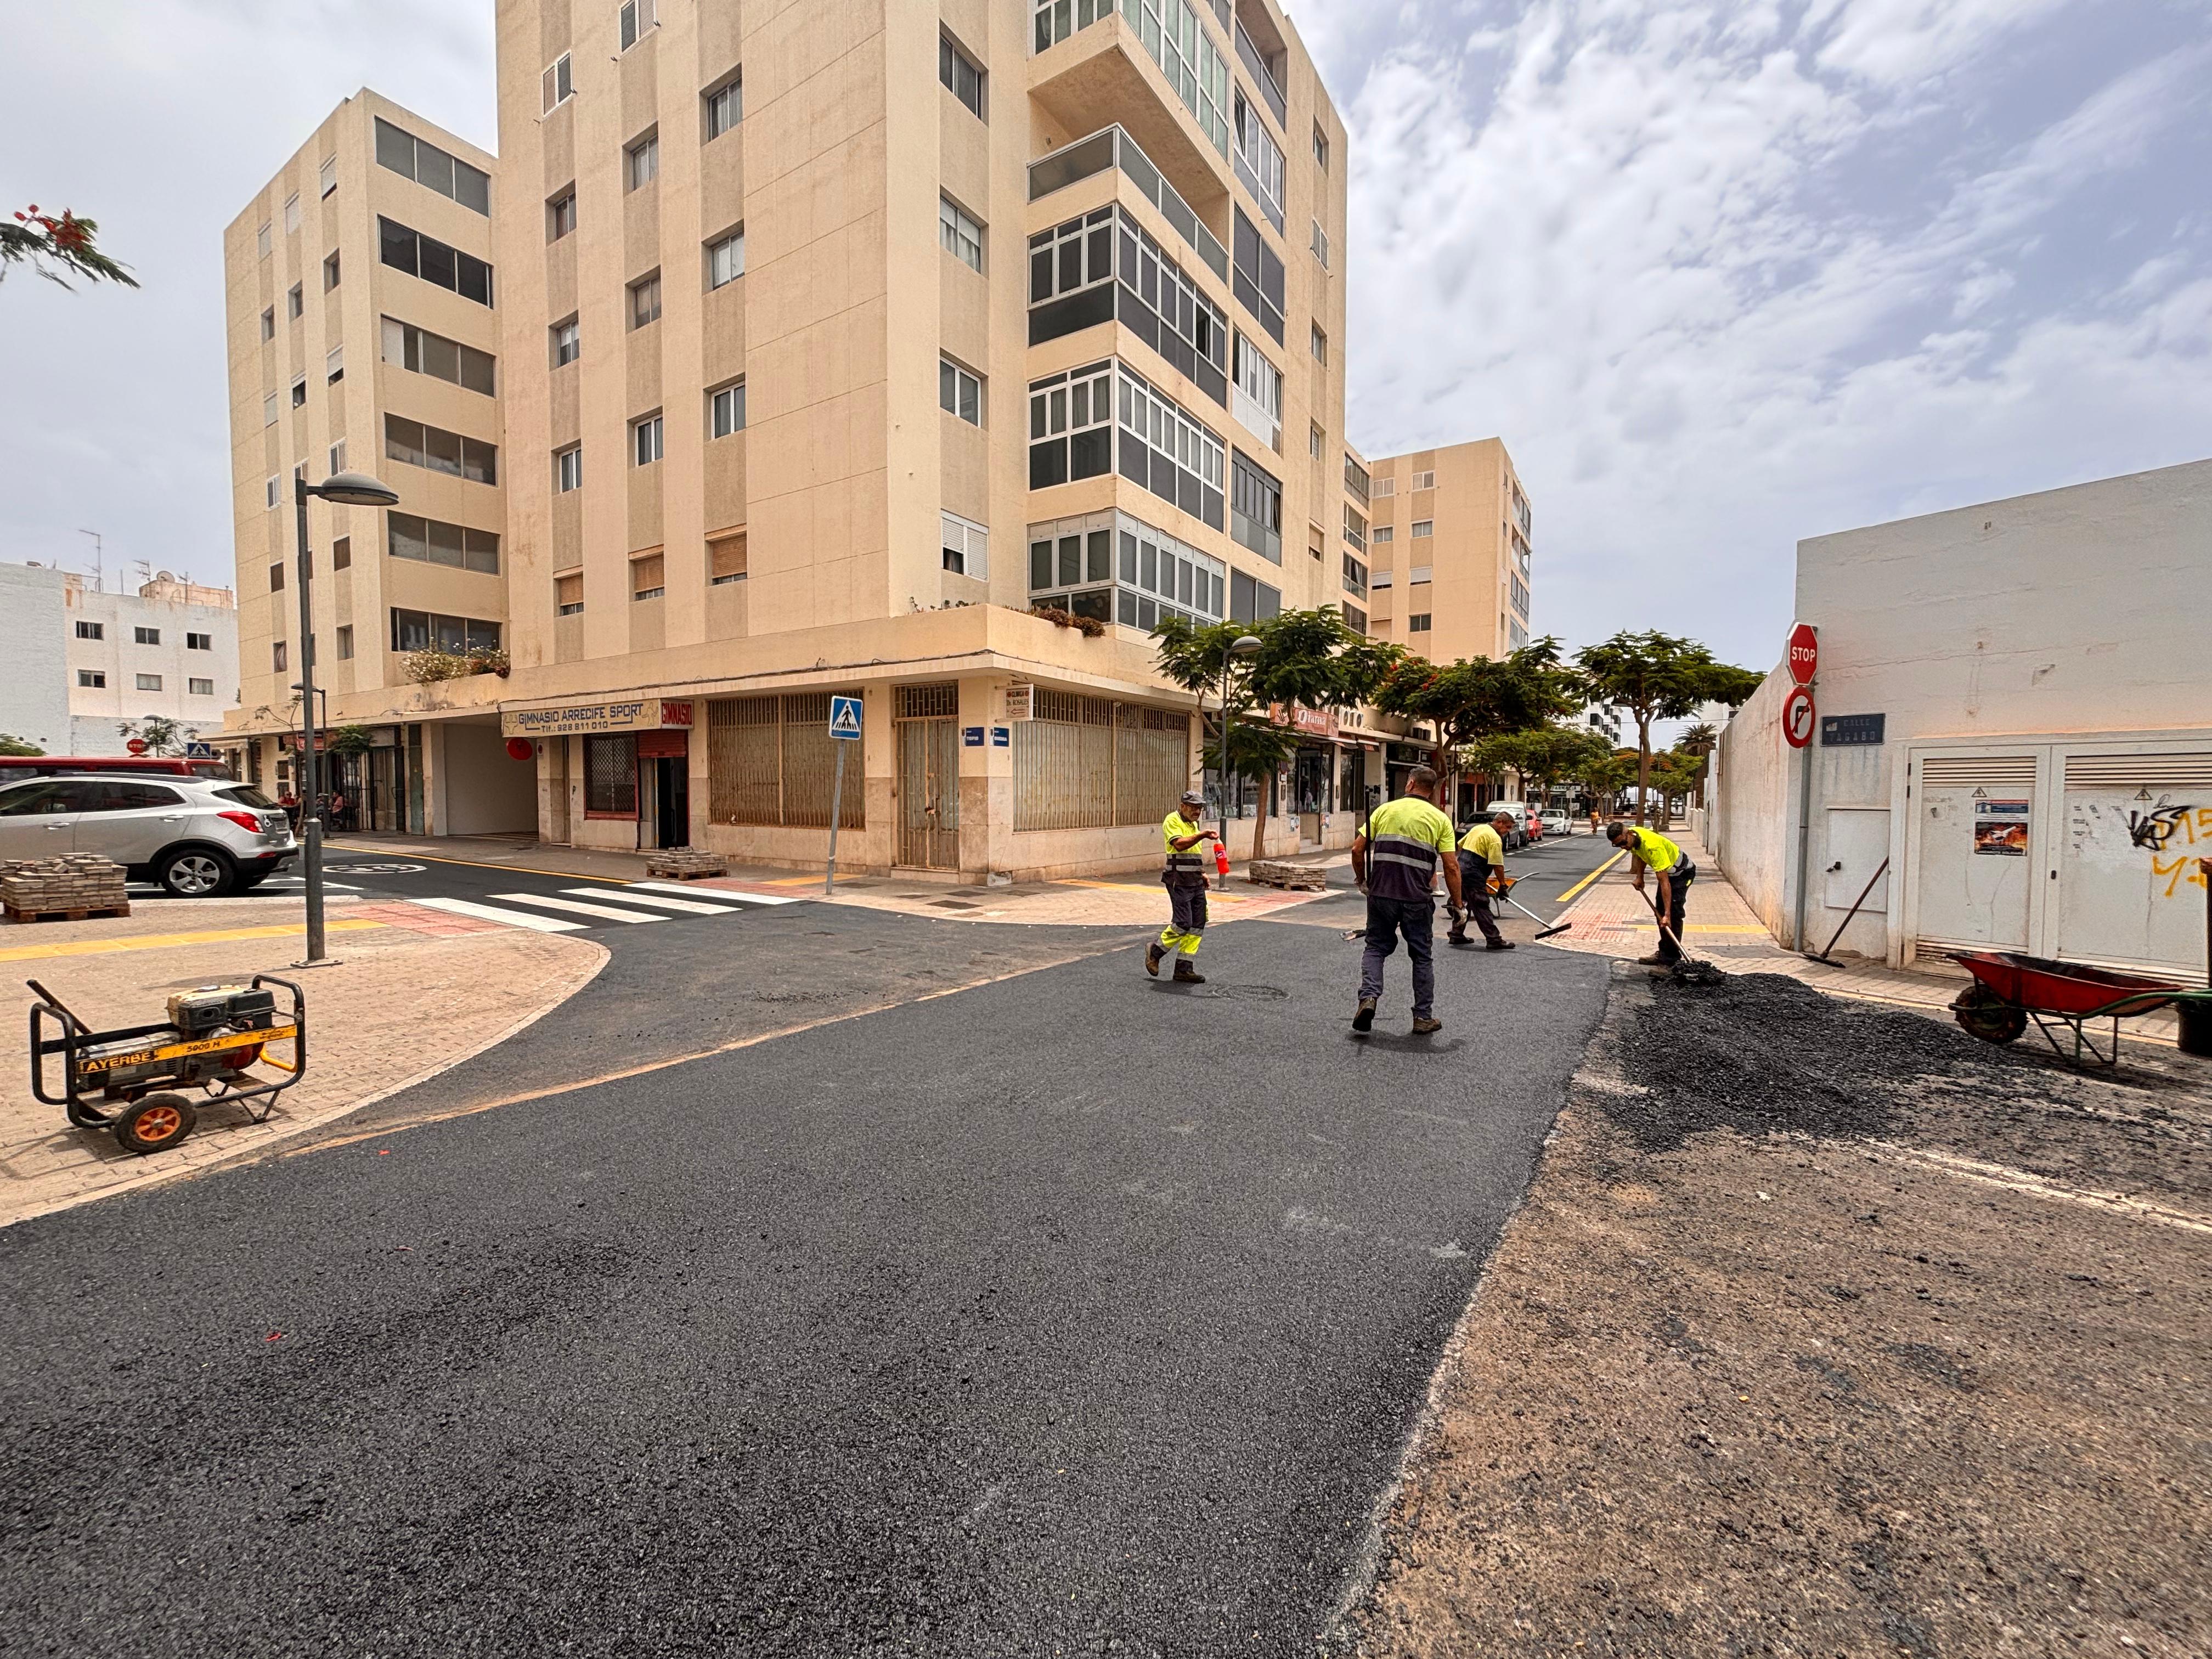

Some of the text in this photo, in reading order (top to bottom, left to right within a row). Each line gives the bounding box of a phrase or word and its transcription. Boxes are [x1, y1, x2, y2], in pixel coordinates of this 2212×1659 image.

[1791, 646, 1816, 662] STOP
[518, 703, 644, 725] GIMNASIO ARRECIFE SPORT
[661, 703, 692, 725] GIMNASIO
[592, 721, 608, 729] 010
[1843, 719, 1870, 727] CALLE
[187, 1043, 210, 1053] 5000
[87, 1051, 151, 1071] AYERBE
